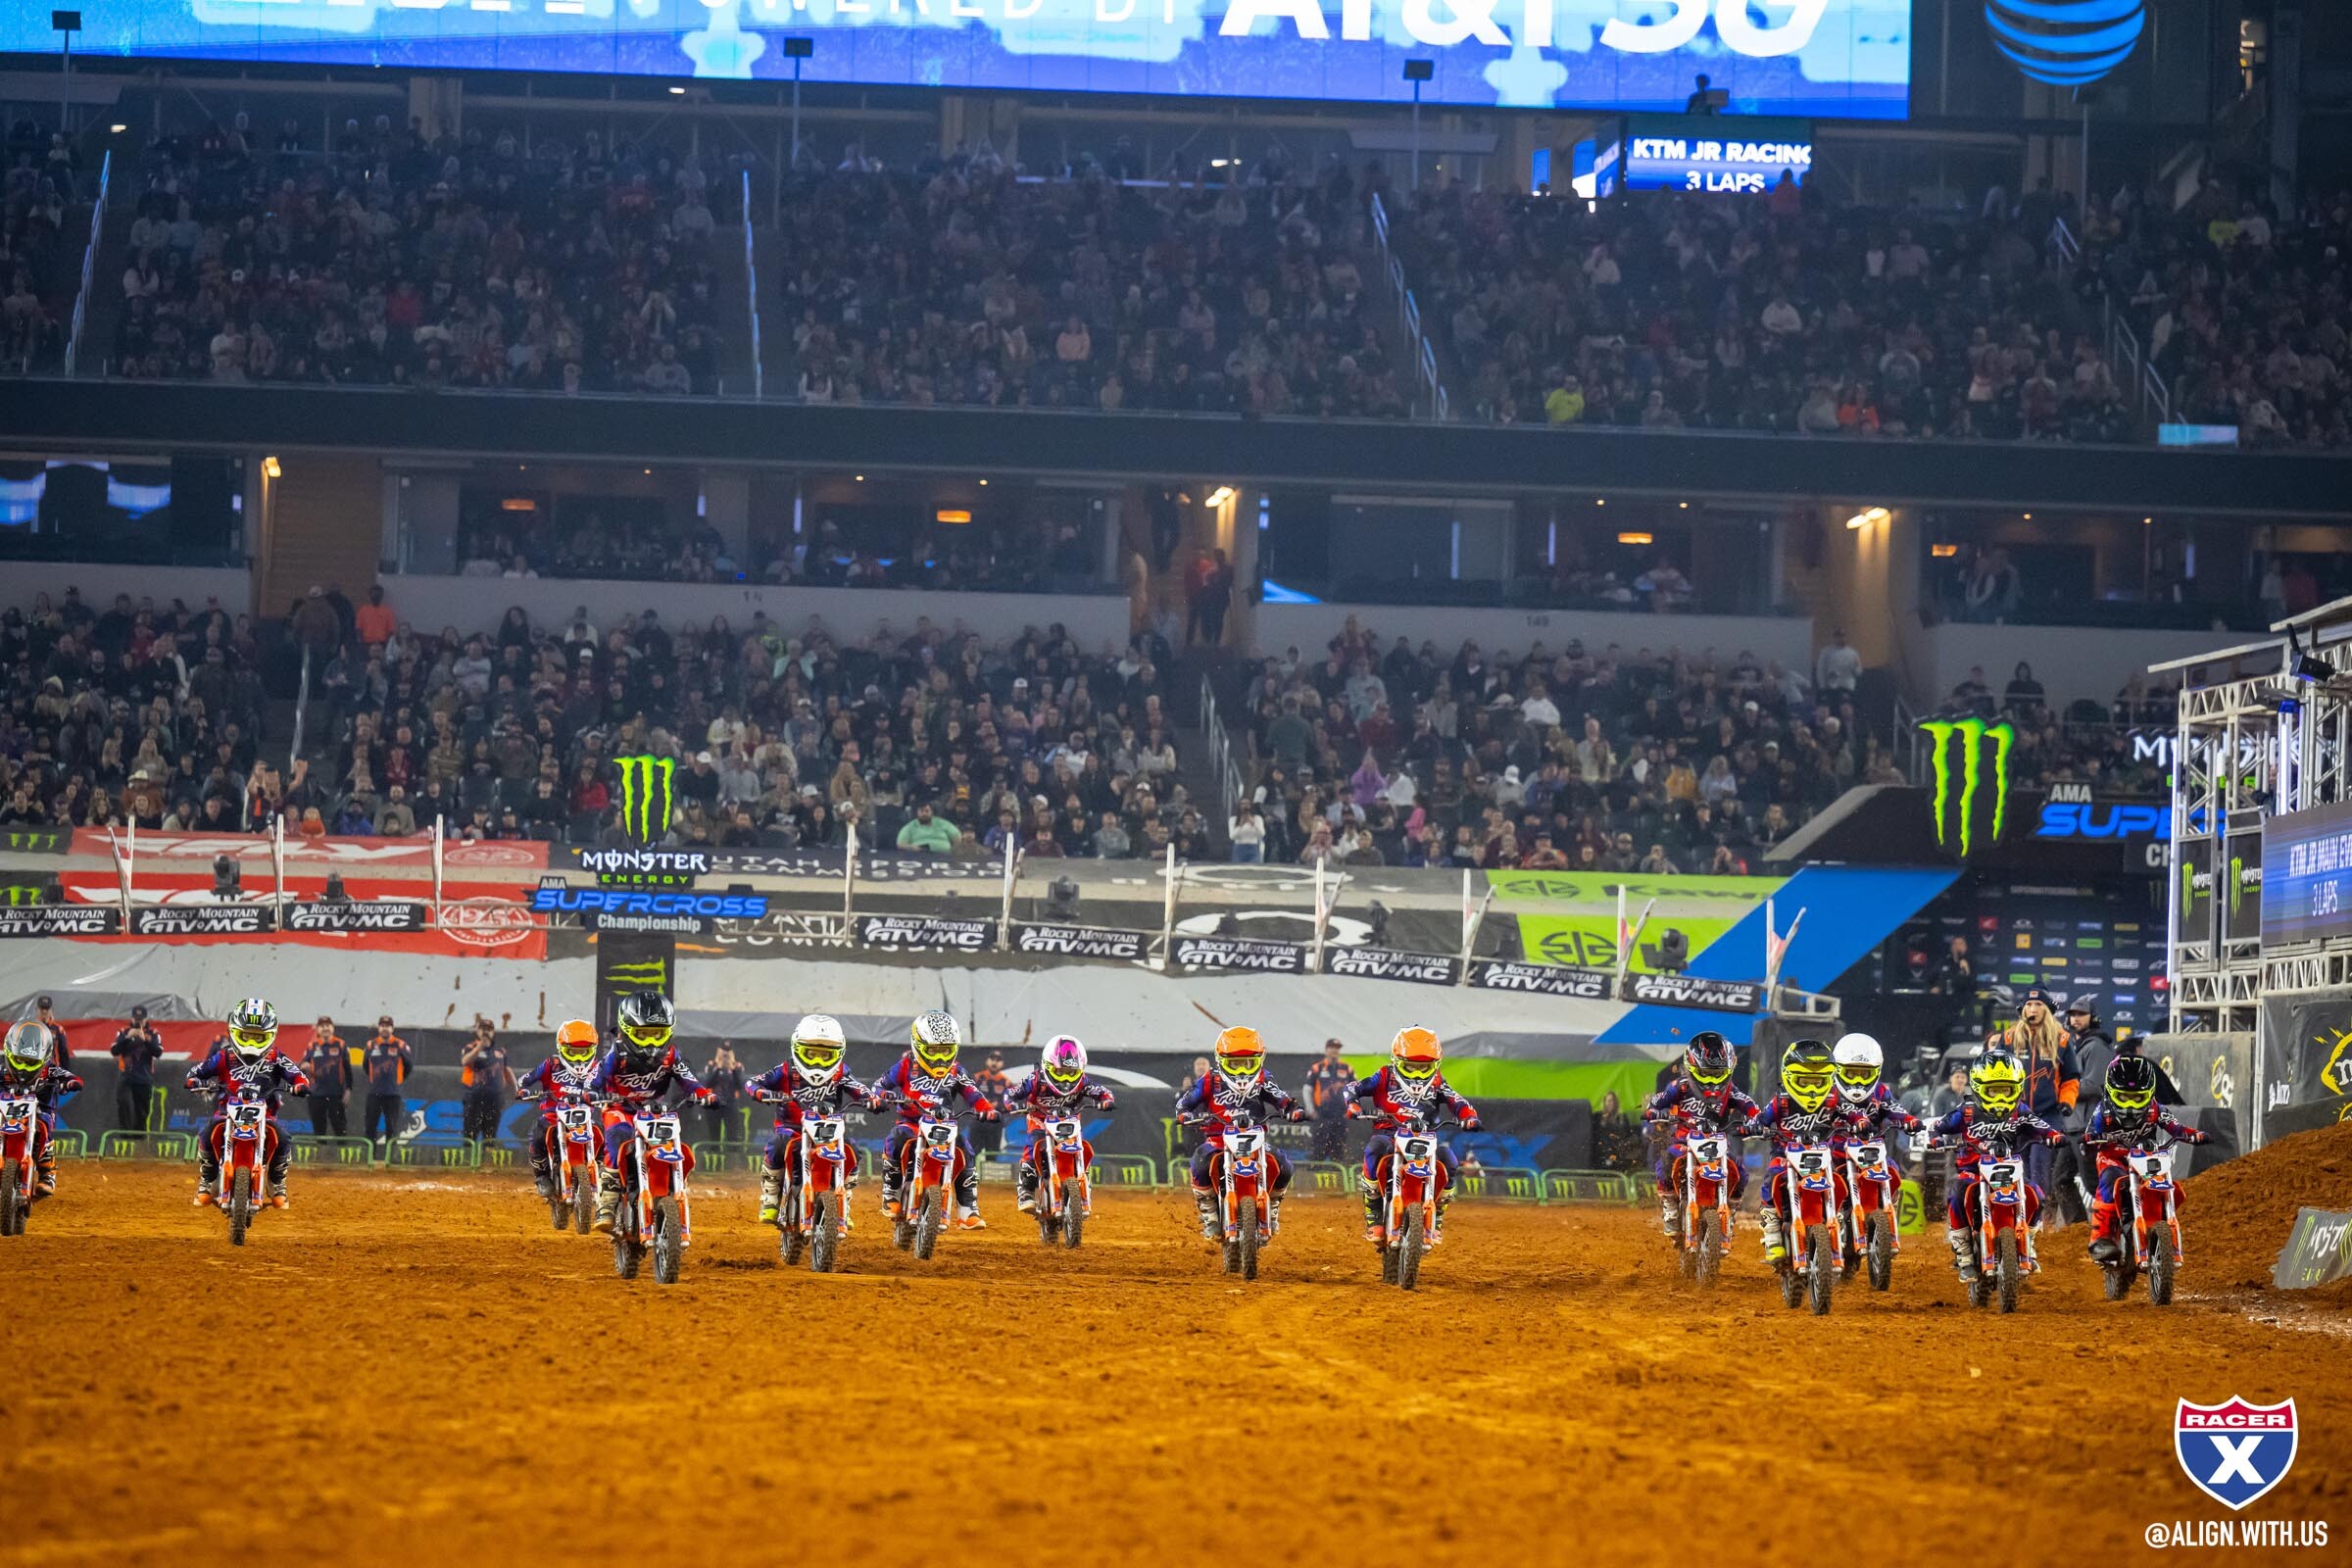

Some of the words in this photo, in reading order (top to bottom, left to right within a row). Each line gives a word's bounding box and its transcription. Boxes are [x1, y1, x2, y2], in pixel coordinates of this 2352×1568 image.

[1633, 138, 1687, 161] KTM
[1690, 140, 1721, 162] JR
[1686, 170, 1701, 191] 3
[1706, 172, 1766, 193] LAPS
[2049, 784, 2091, 803] AMA
[581, 849, 709, 872] MONSTER
[601, 873, 689, 885] ENERGY
[532, 888, 768, 918] SUPERCROSS
[2318, 879, 2338, 916] LAPS
[44, 907, 107, 920] MOUNTAIN
[198, 907, 259, 919] MOUNTAIN
[349, 904, 412, 914] MOUNTAIN
[597, 912, 702, 934] Championship
[923, 918, 986, 933] MOUNTAIN
[1077, 928, 1140, 944] MOUNTAIN
[1236, 942, 1298, 956] MOUNTAIN
[1390, 952, 1451, 968] MOUNTAIN
[1543, 968, 1603, 985] MOUNTAIN
[1692, 979, 1754, 995] MOUNTAIN
